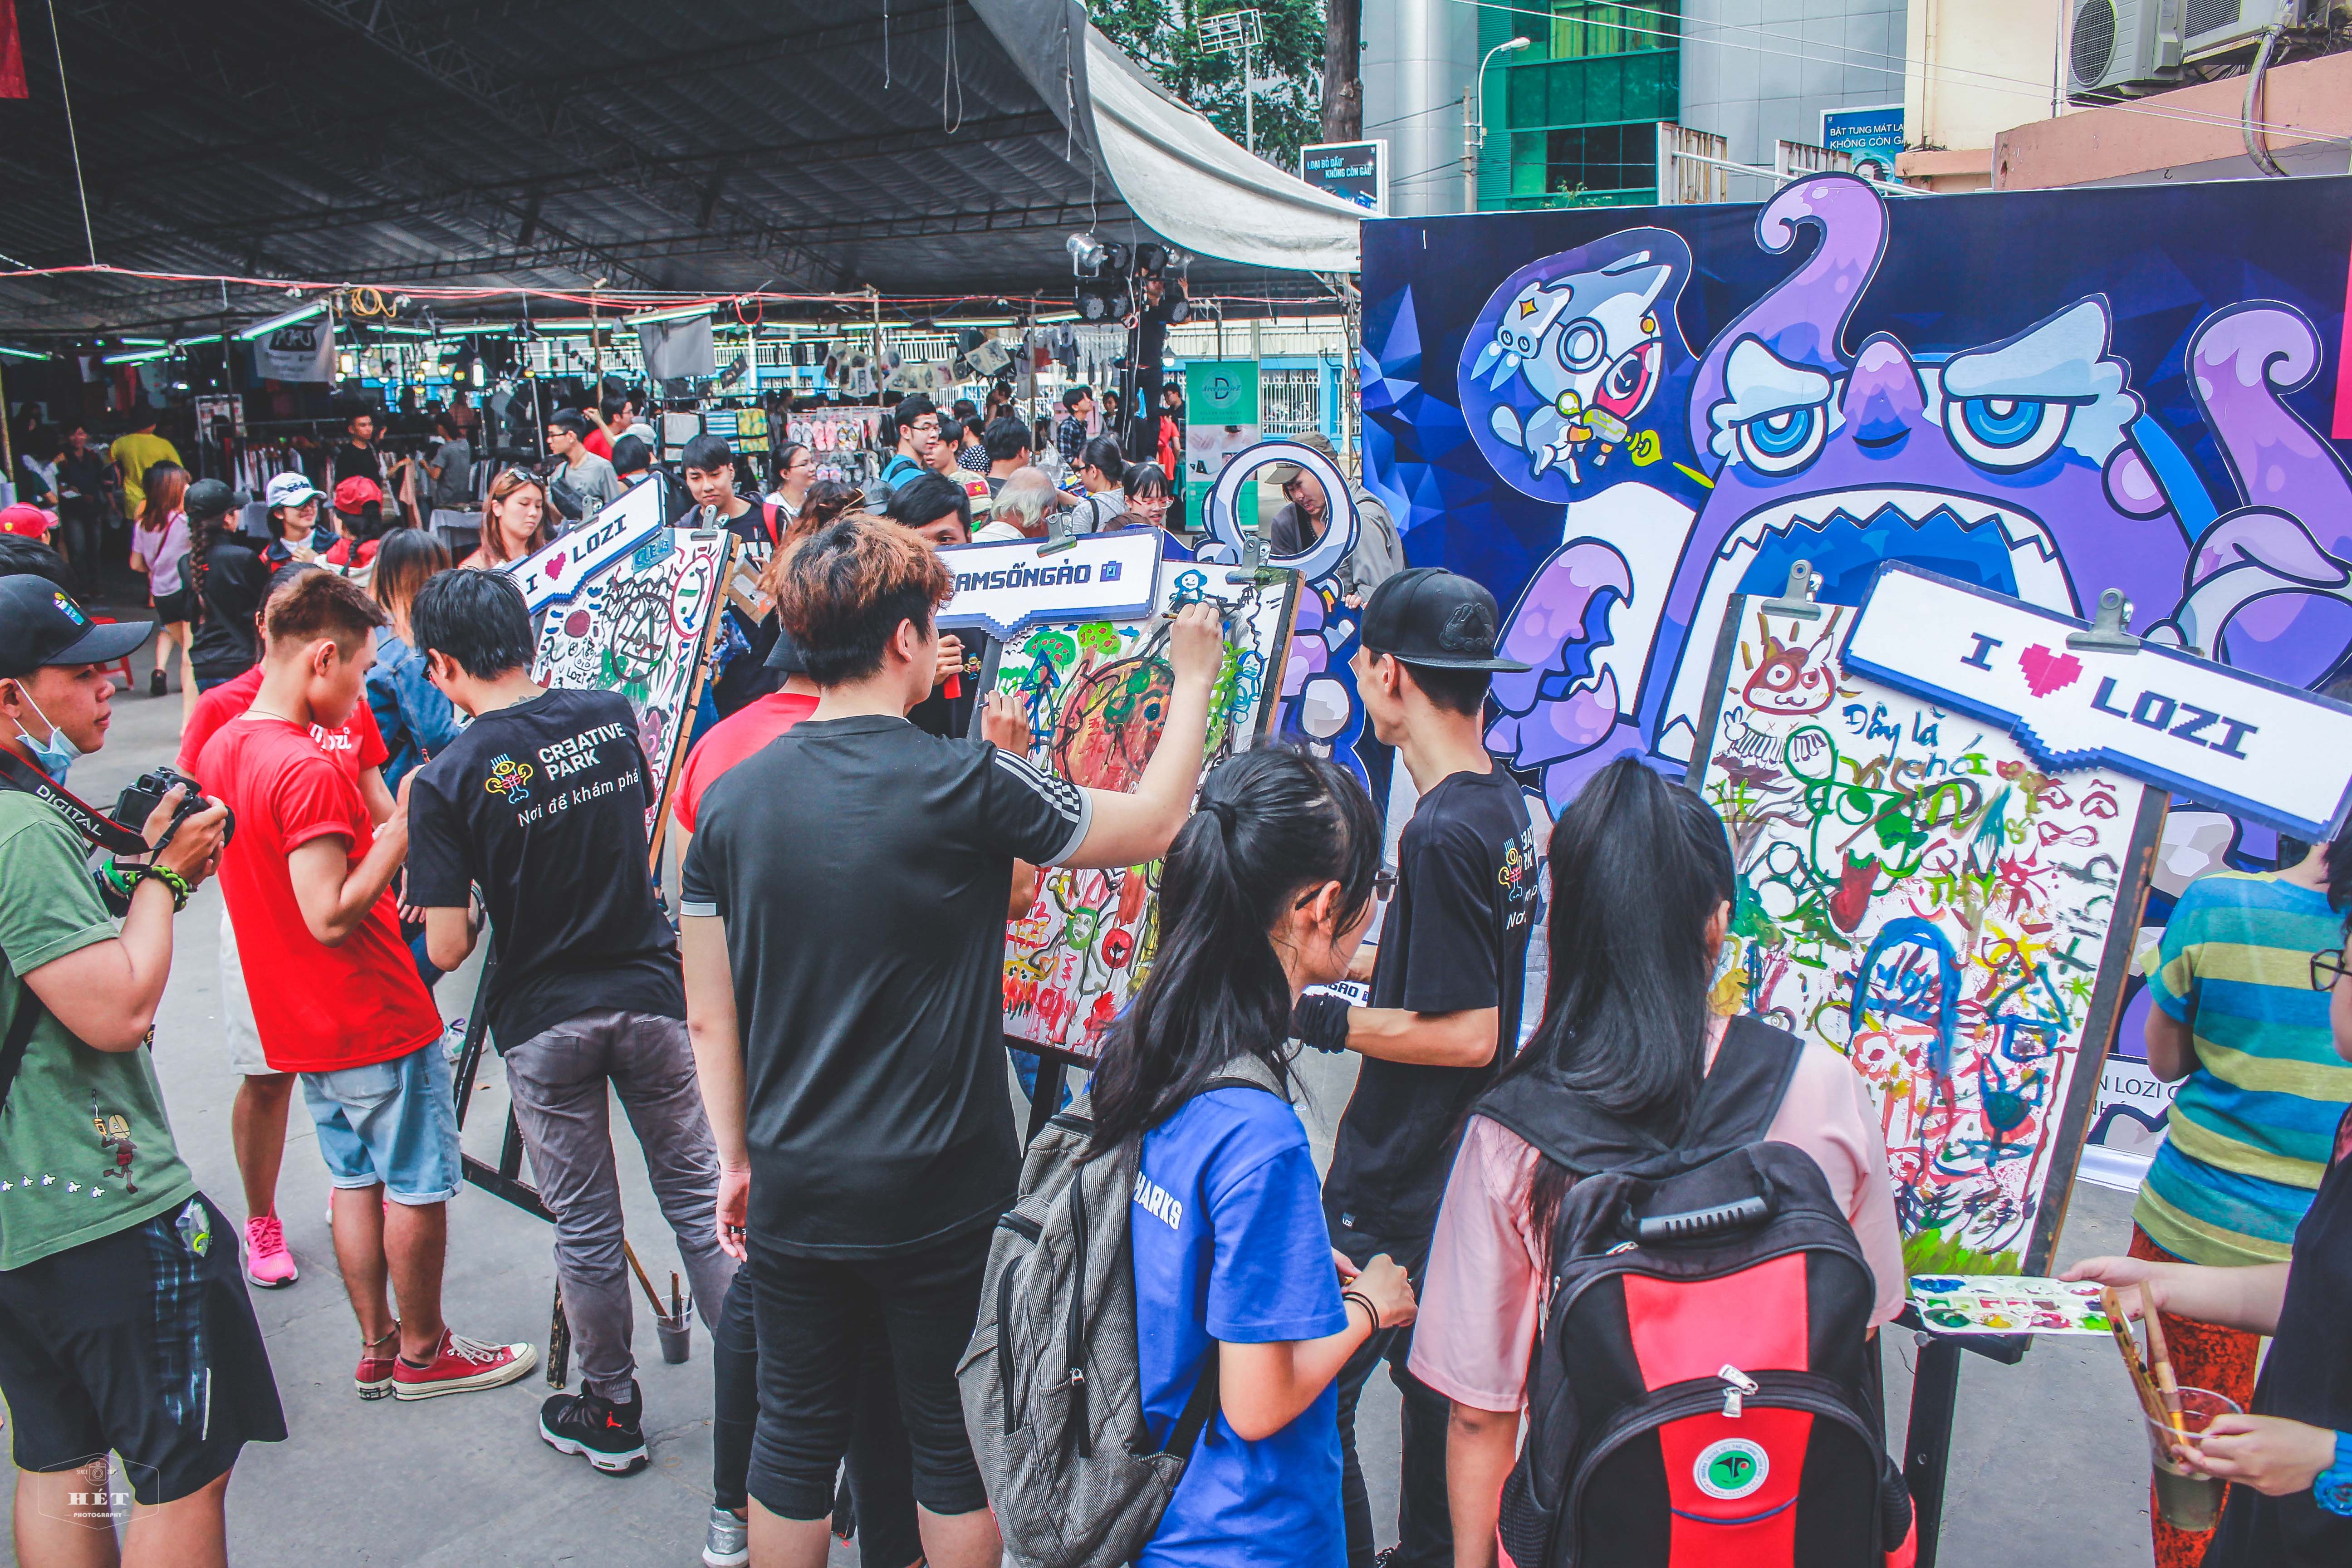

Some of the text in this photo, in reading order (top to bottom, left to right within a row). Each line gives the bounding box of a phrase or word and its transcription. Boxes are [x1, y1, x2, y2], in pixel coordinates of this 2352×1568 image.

[1830, 123, 1904, 137] BẬT TUNG MÁT LẠ
[1830, 137, 1866, 150] KHÔNG
[1869, 136, 1891, 147] CÒN
[526, 514, 627, 595] I LOZI
[955, 558, 1092, 592] AMSỐNGẢO
[1960, 632, 2259, 760] I LOZI
[544, 748, 601, 781] PARK
[36, 784, 102, 836] DIGITAL
[518, 768, 640, 827] Nơi để khám phá
[2114, 1076, 2161, 1099] LOZI
[1133, 1170, 1184, 1231] HARKS
